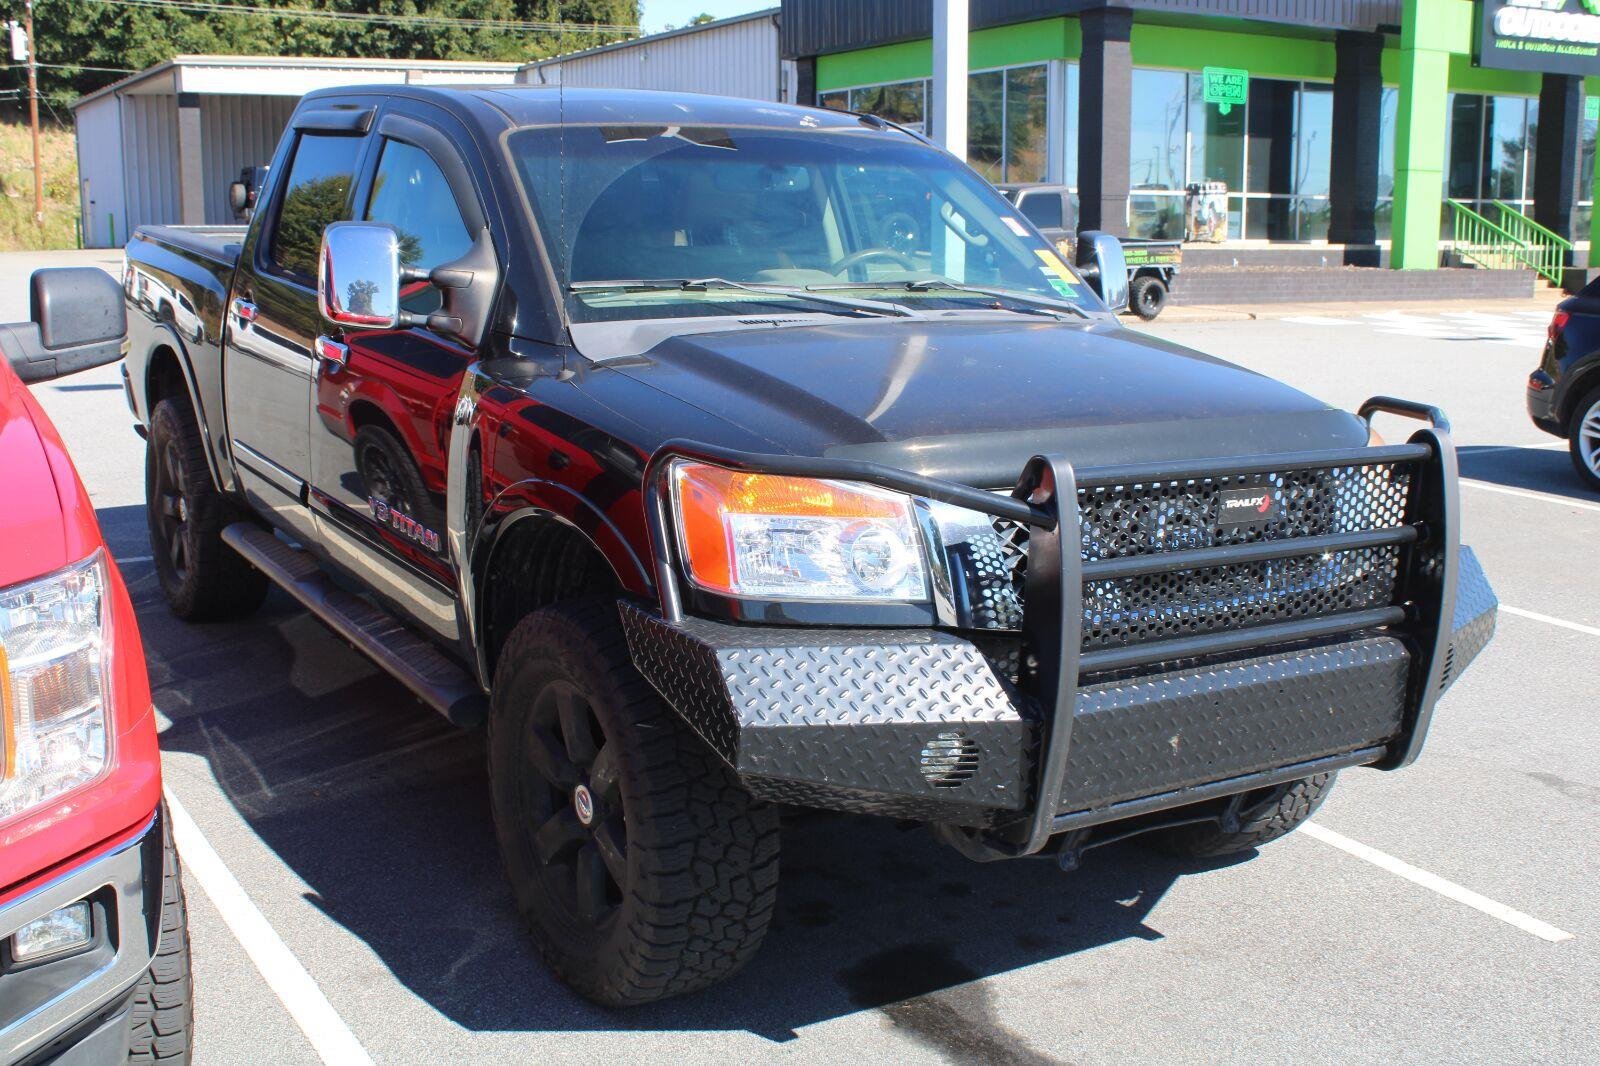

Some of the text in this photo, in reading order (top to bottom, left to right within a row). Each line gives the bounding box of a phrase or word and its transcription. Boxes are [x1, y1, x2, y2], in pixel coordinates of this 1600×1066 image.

[1494, 6, 1600, 43] OUTDOOR
[1495, 39, 1516, 50] TRUCK
[1209, 74, 1243, 85] WE ARE
[1209, 84, 1242, 98] OPEN
[390, 507, 440, 552] TITAN
